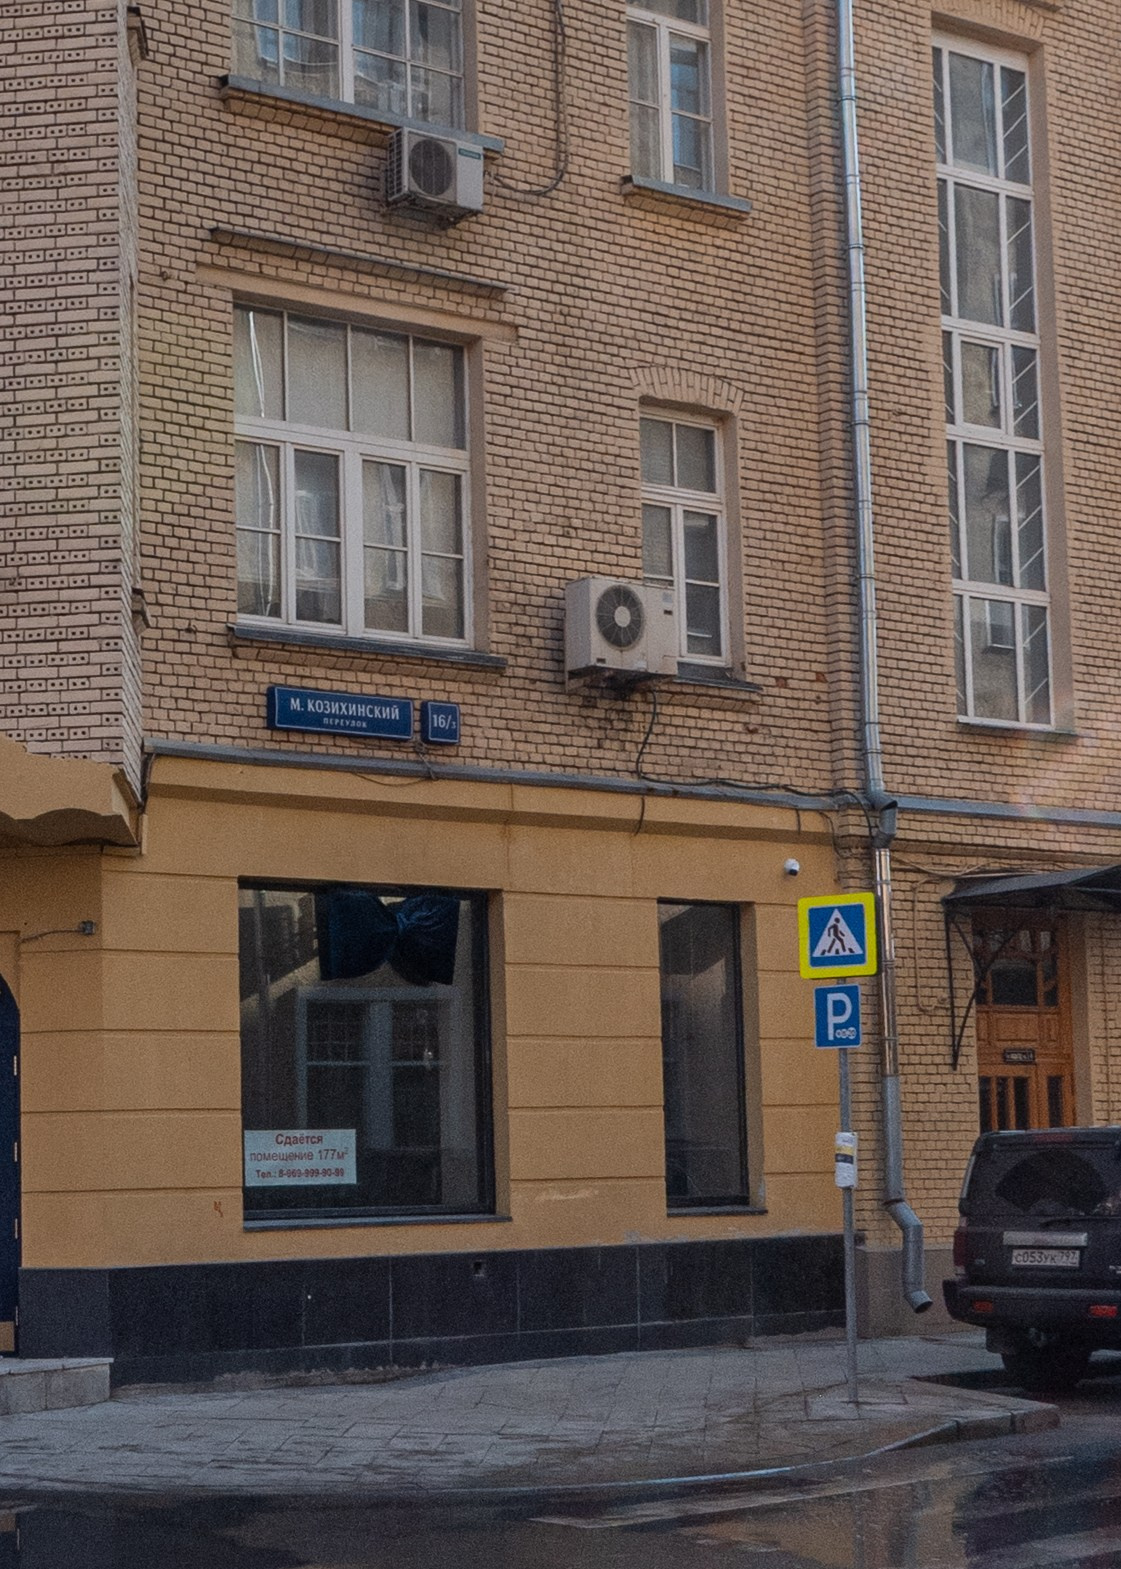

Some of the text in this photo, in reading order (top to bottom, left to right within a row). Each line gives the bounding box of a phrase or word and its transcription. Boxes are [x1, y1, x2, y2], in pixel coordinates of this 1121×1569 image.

[290, 697, 400, 720] М. КОЗИХИНСКИЙ
[323, 717, 367, 728] ПЕРЕУЛОК
[826, 992, 853, 1041] P
[275, 1133, 323, 1146] Сдаётся
[250, 1150, 314, 1162] помещение
